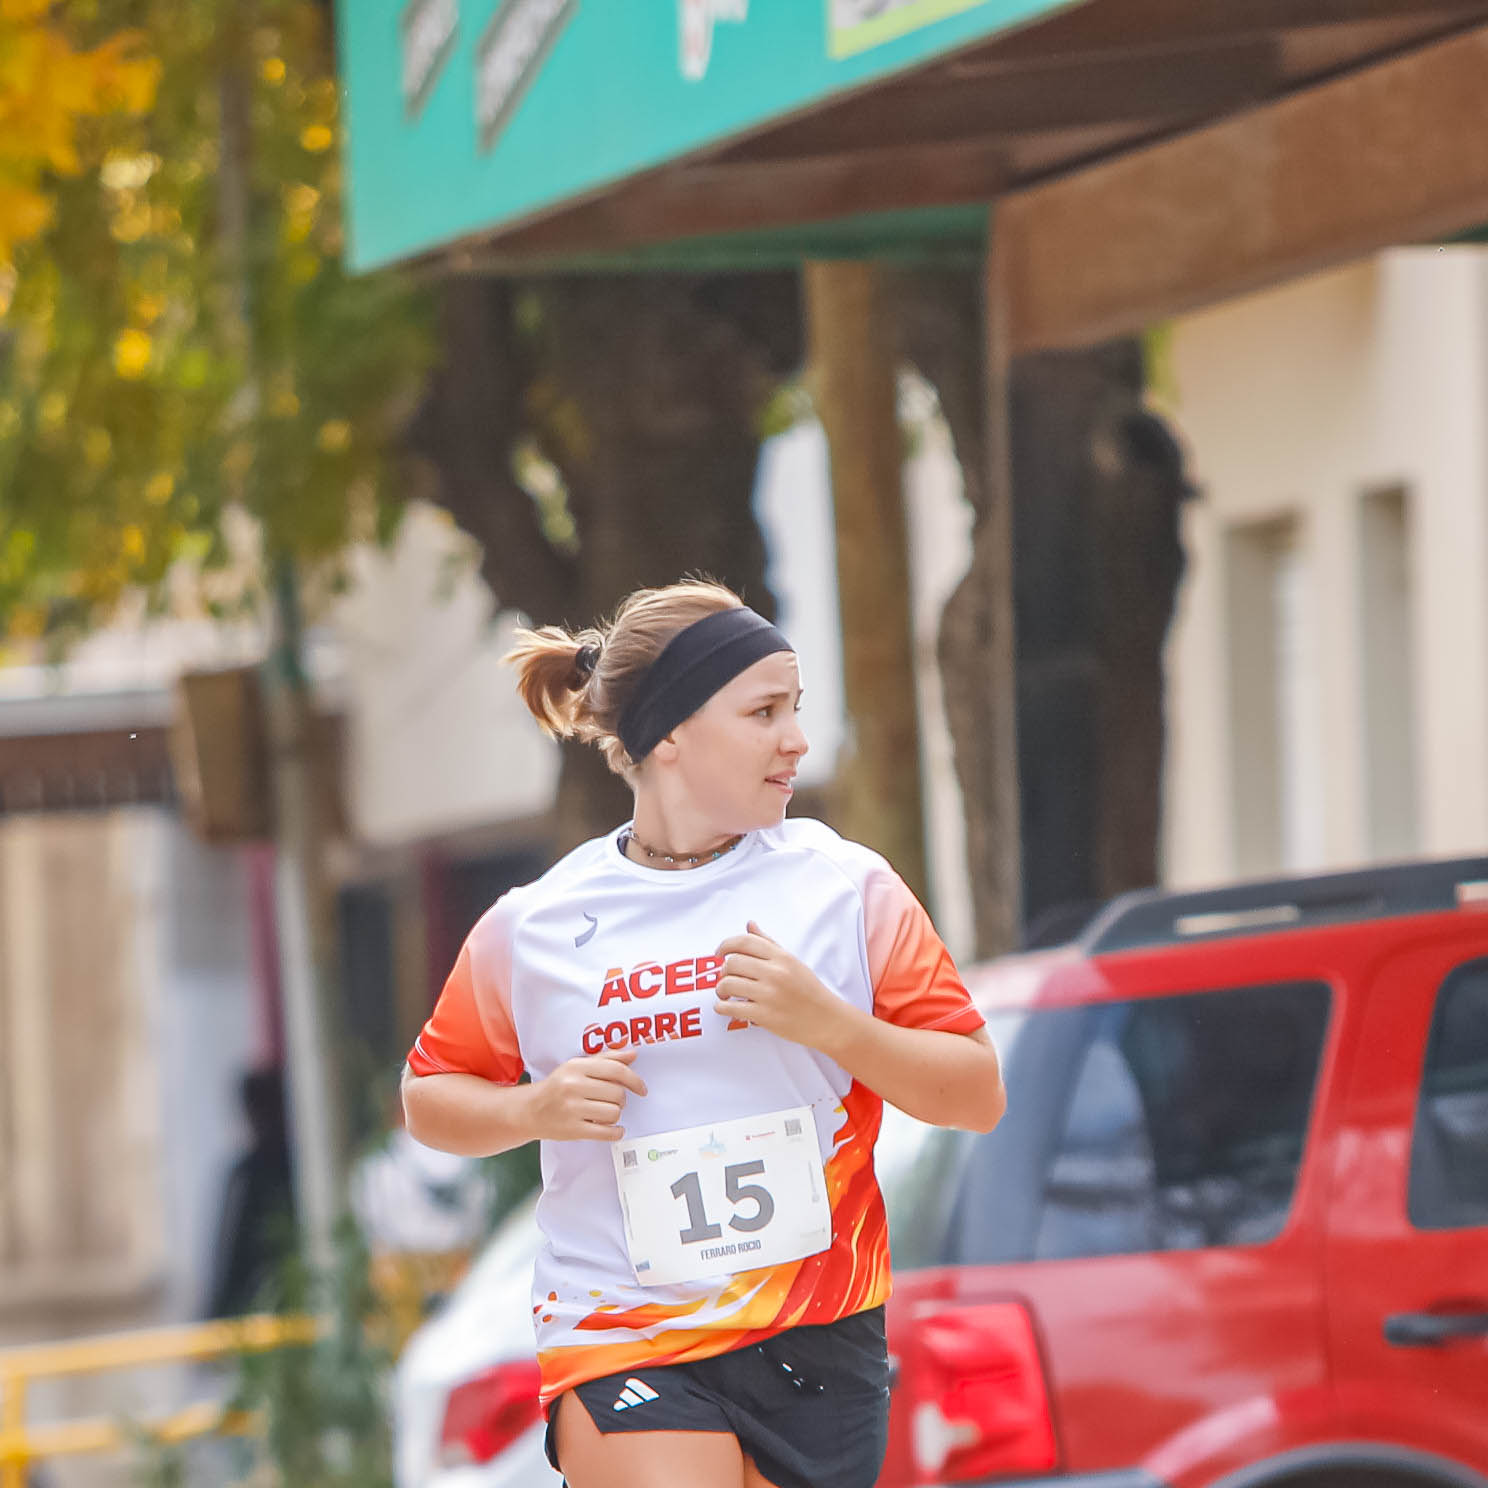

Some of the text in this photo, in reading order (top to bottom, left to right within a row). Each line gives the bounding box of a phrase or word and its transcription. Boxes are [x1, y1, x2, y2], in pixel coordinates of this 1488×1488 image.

[598, 955, 726, 1007] ACEB
[582, 1007, 702, 1054] CORRE
[670, 1159, 775, 1245] 15
[700, 1239, 762, 1260] FERRARO ROCIO
